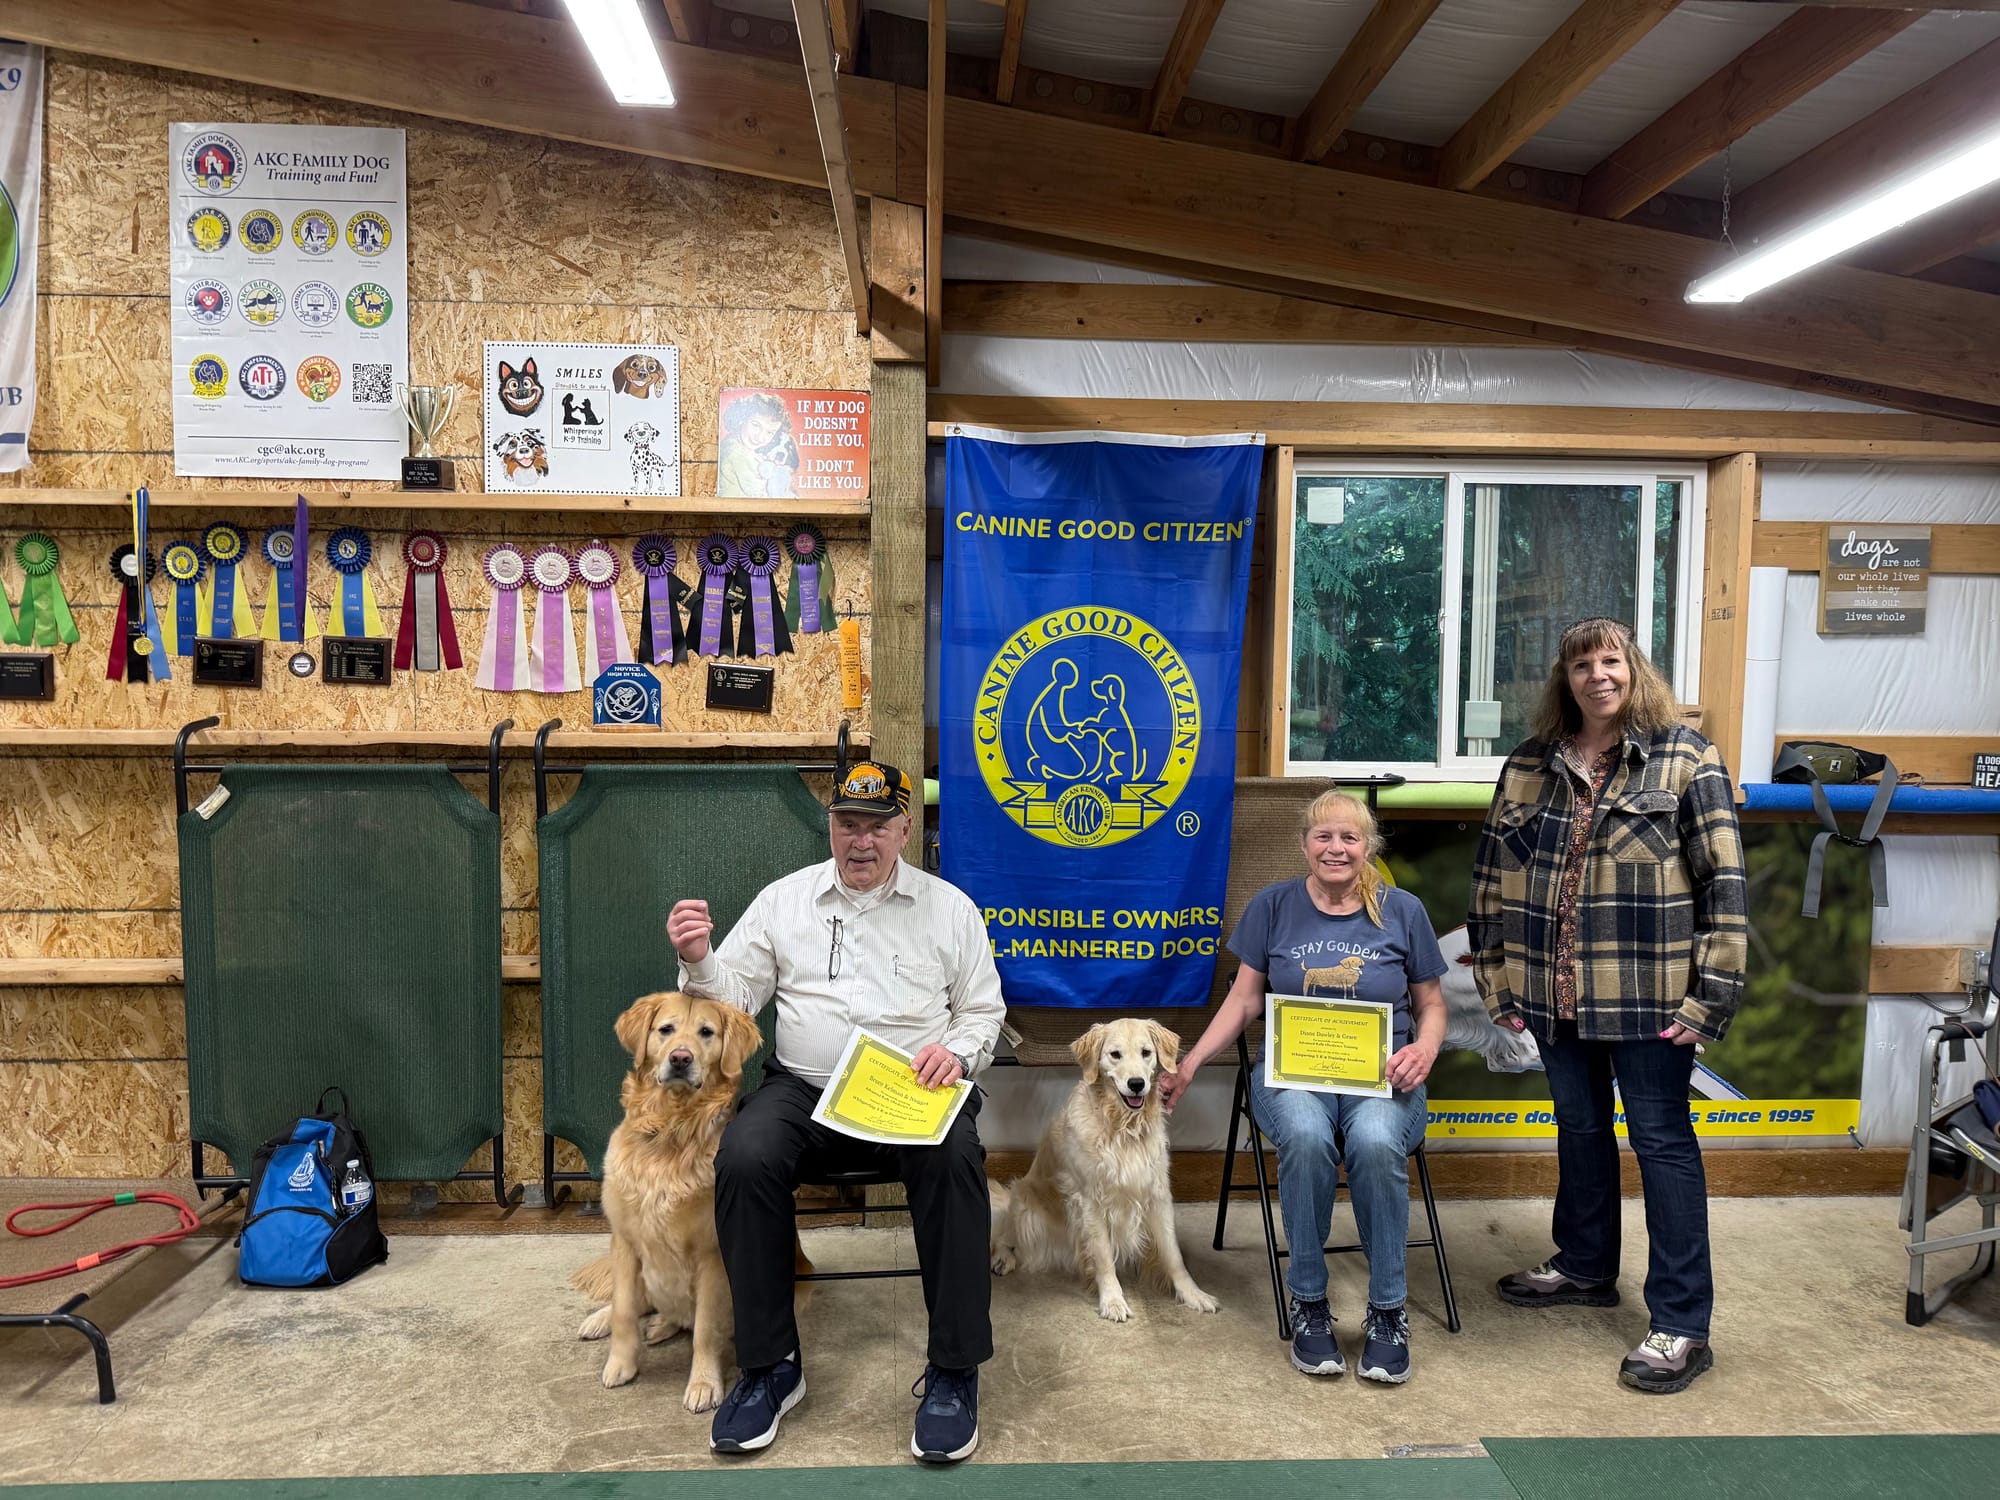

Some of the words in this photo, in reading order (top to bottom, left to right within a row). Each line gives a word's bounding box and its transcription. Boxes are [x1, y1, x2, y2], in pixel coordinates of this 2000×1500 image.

[208, 135, 224, 143] DOG
[225, 139, 243, 174] PROGRAM
[253, 152, 288, 166] AKC
[292, 153, 349, 168] FAMILY
[353, 154, 390, 169] DOG
[267, 168, 321, 185] Training
[324, 172, 346, 183] and
[349, 171, 379, 183] Fun!
[187, 291, 195, 307] AKC
[222, 289, 230, 308] DOG
[240, 287, 250, 303] AKC
[272, 286, 284, 304] DOG
[348, 286, 363, 303] AKC
[374, 286, 390, 303] DOG
[252, 366, 273, 385] ATT
[555, 367, 603, 378] SMILES
[797, 400, 811, 413] IF
[814, 400, 835, 413] MY
[838, 400, 866, 414] DOG
[804, 417, 858, 430] DOESN'T
[577, 436, 602, 445] Training
[799, 433, 832, 447] LIKE
[836, 434, 865, 449] YOU,
[257, 444, 326, 458] cgc@akc.org
[215, 456, 370, 468] www.AKC.org/sports/akc-family-dog-program/
[807, 459, 813, 472] I
[816, 459, 855, 472] DON'T
[798, 475, 831, 489] LIKE
[835, 476, 864, 489] YOU.
[956, 511, 1052, 539] CANINE
[1058, 519, 1136, 541] GOOD
[1841, 530, 1900, 570] dogs
[1882, 559, 1900, 567] are
[1903, 558, 1921, 567] not
[1838, 573, 1856, 581] our
[1860, 572, 1889, 581] whole
[1893, 572, 1920, 581] lives
[1856, 584, 1873, 594] but
[1877, 584, 1900, 596] they
[1853, 597, 1878, 607] make
[1881, 599, 1900, 607] our
[1845, 612, 1872, 621] lives
[1876, 611, 1906, 621] whole
[977, 631, 1037, 745] CANINE
[1042, 610, 1134, 639] GOOD
[1138, 632, 1198, 753] CITIZEN
[1977, 756, 1983, 764] A
[1057, 786, 1079, 819] AMERICAN
[1080, 786, 1104, 801] KENNEL
[1103, 801, 1111, 819] CLUB
[1066, 796, 1100, 834] AKC
[1064, 832, 1088, 843] FOUNDED
[978, 907, 1105, 928] PONSIBLE
[1291, 940, 1324, 959] STAY
[869, 1058, 900, 1077] CERTIFICATE
[1706, 1109, 1761, 1123] since
[1769, 1110, 1815, 1123] 1995
